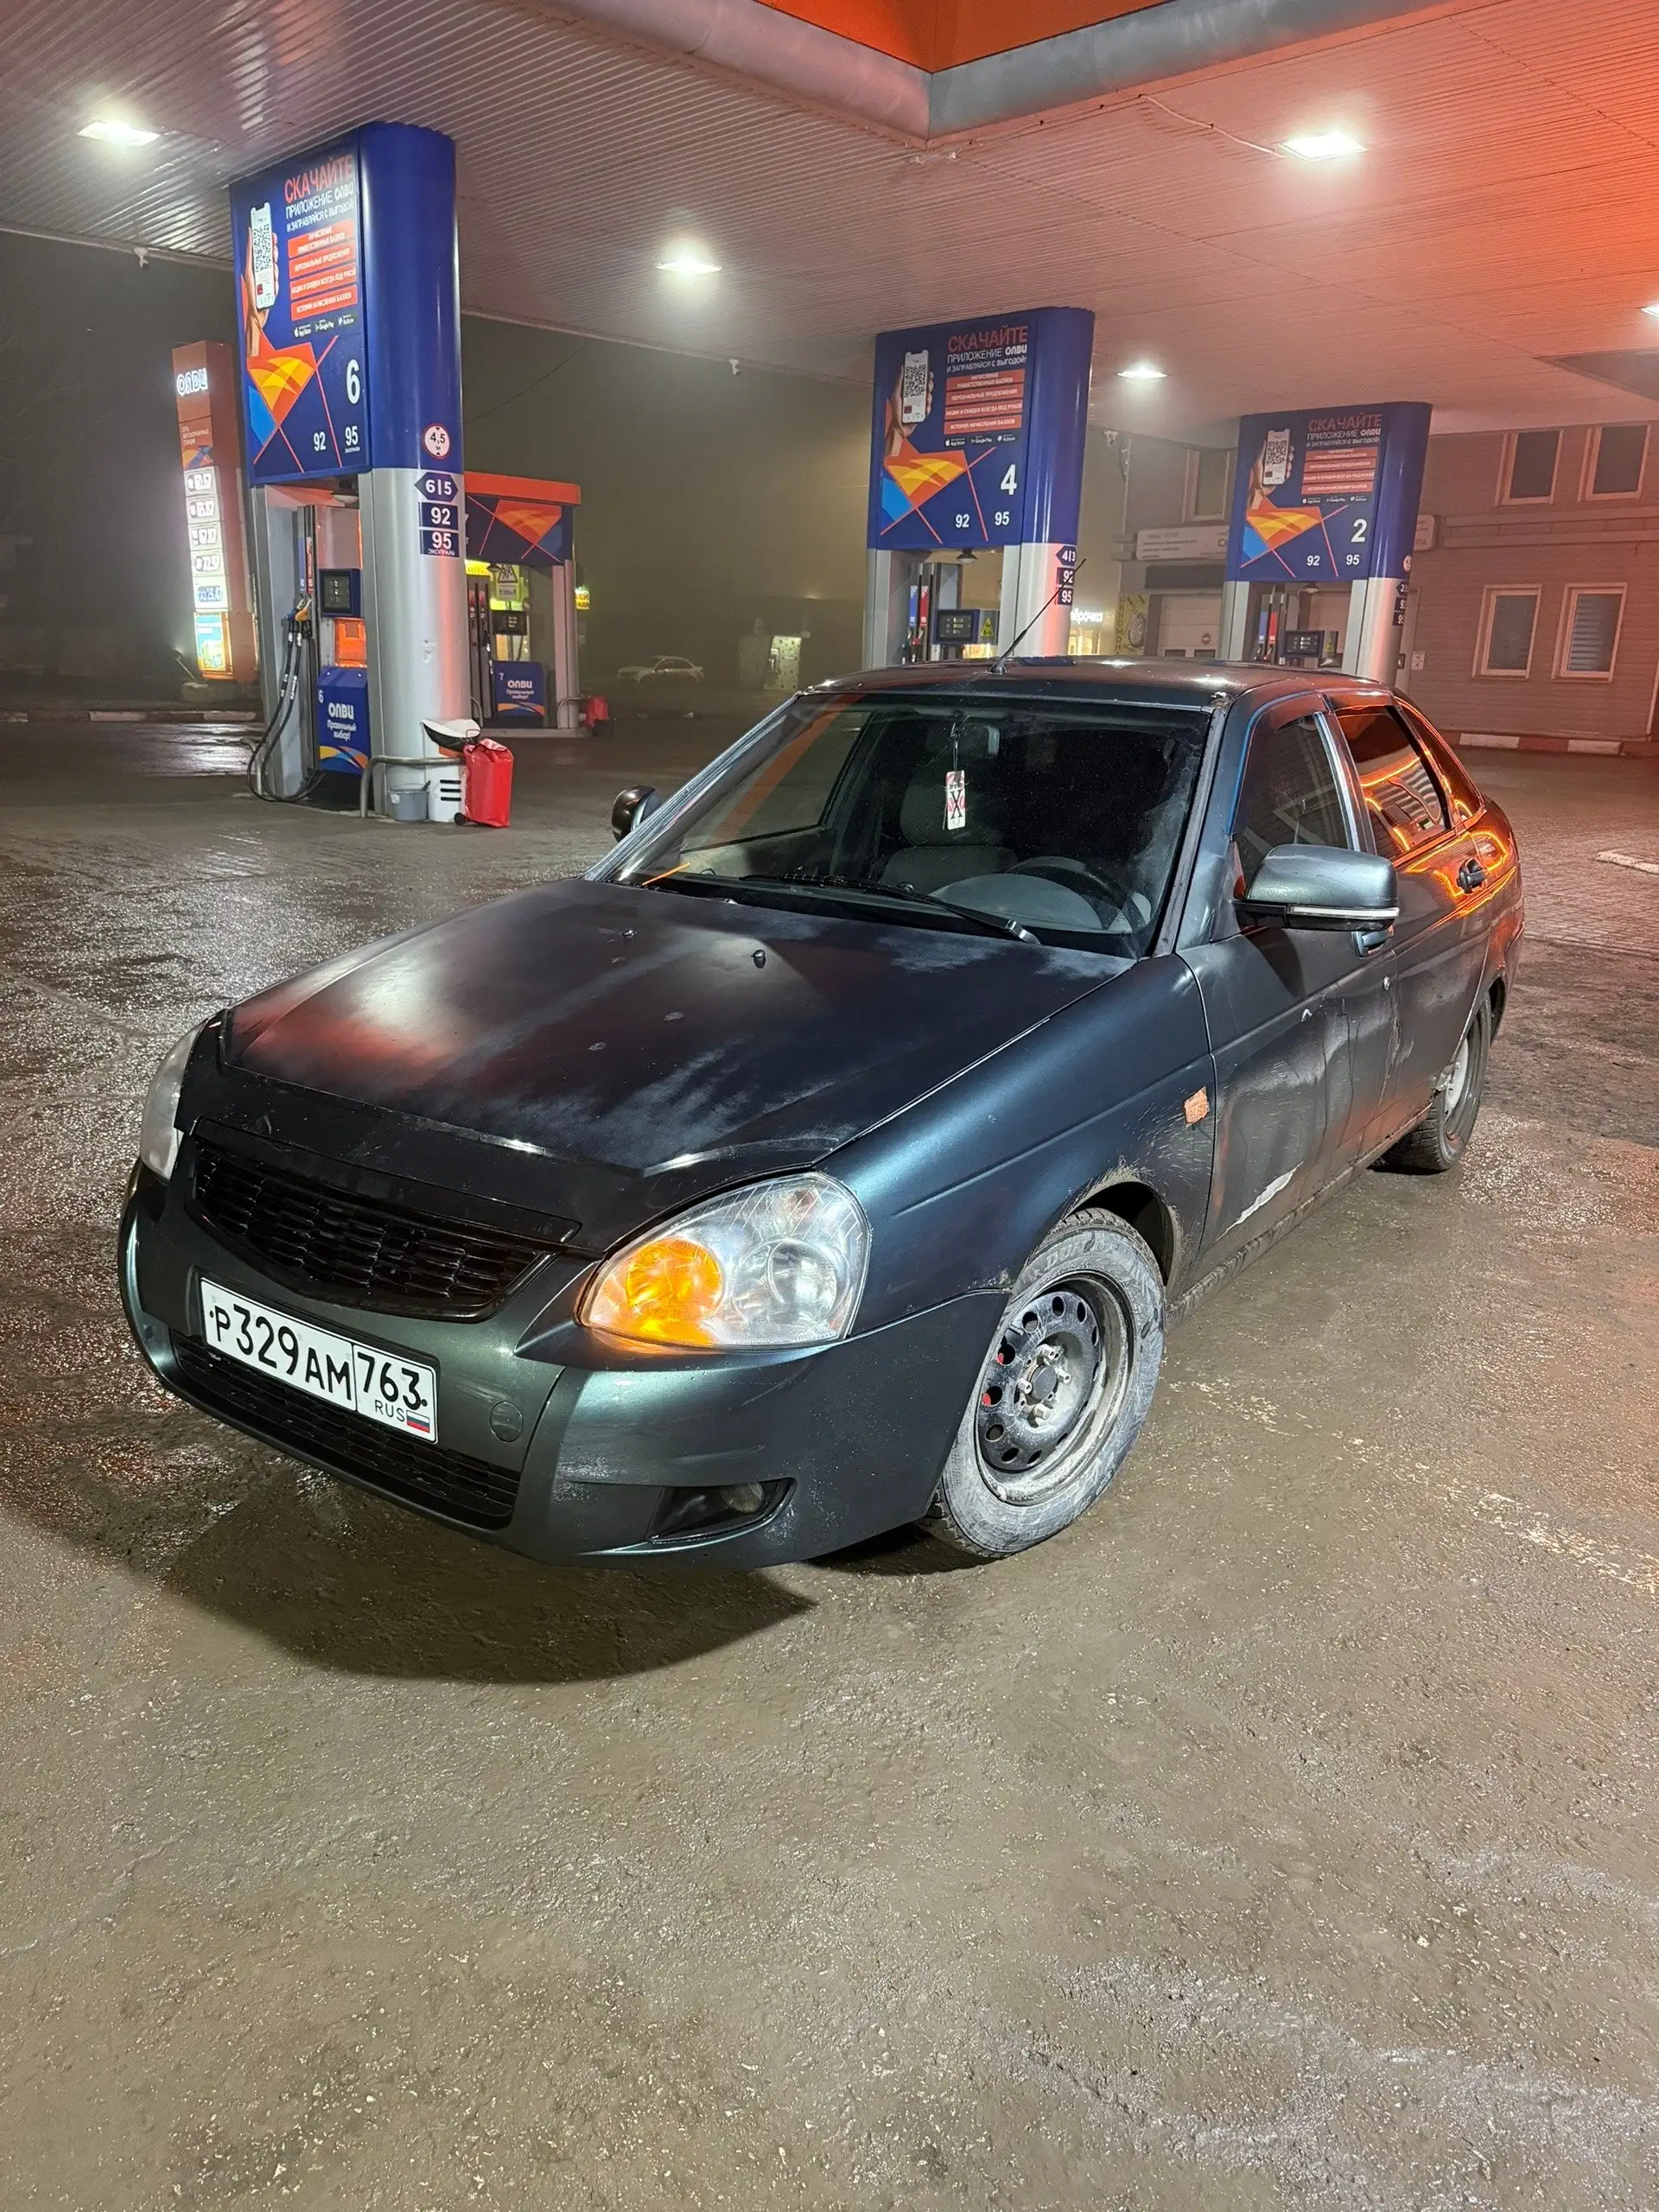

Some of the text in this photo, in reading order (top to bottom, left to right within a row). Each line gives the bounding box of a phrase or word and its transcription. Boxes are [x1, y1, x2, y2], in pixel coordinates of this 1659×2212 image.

[284, 154, 353, 204] СКАЧАЙТЕ
[286, 190, 333, 219] ПРИЛОЖЕНИЕ
[948, 324, 1027, 353] СКАЧАЙТЕ
[947, 347, 1001, 363] ПРИЛОЖЕНИЕ
[346, 359, 360, 404] 6
[1308, 413, 1382, 431] СКАЧАЙТЕ
[314, 426, 359, 452] 92 95
[1307, 432, 1358, 441] ПРИЛОЖЕНИЕ
[1001, 464, 1018, 496] 4
[431, 507, 450, 524] 92
[955, 512, 1010, 528] 92 95
[1351, 518, 1368, 543] 2
[432, 532, 452, 550] 95
[1306, 555, 1360, 566] 92 95
[1063, 570, 1074, 583] 92
[1061, 590, 1071, 603] 95
[499, 672, 504, 681] 7
[507, 679, 532, 689] ОЛВИ
[318, 690, 324, 703] 6
[328, 702, 354, 720] ОЛВИ
[327, 719, 357, 731] Правильный
[214, 1303, 422, 1410] Р329АМ 763
[374, 1400, 405, 1422] RUS
